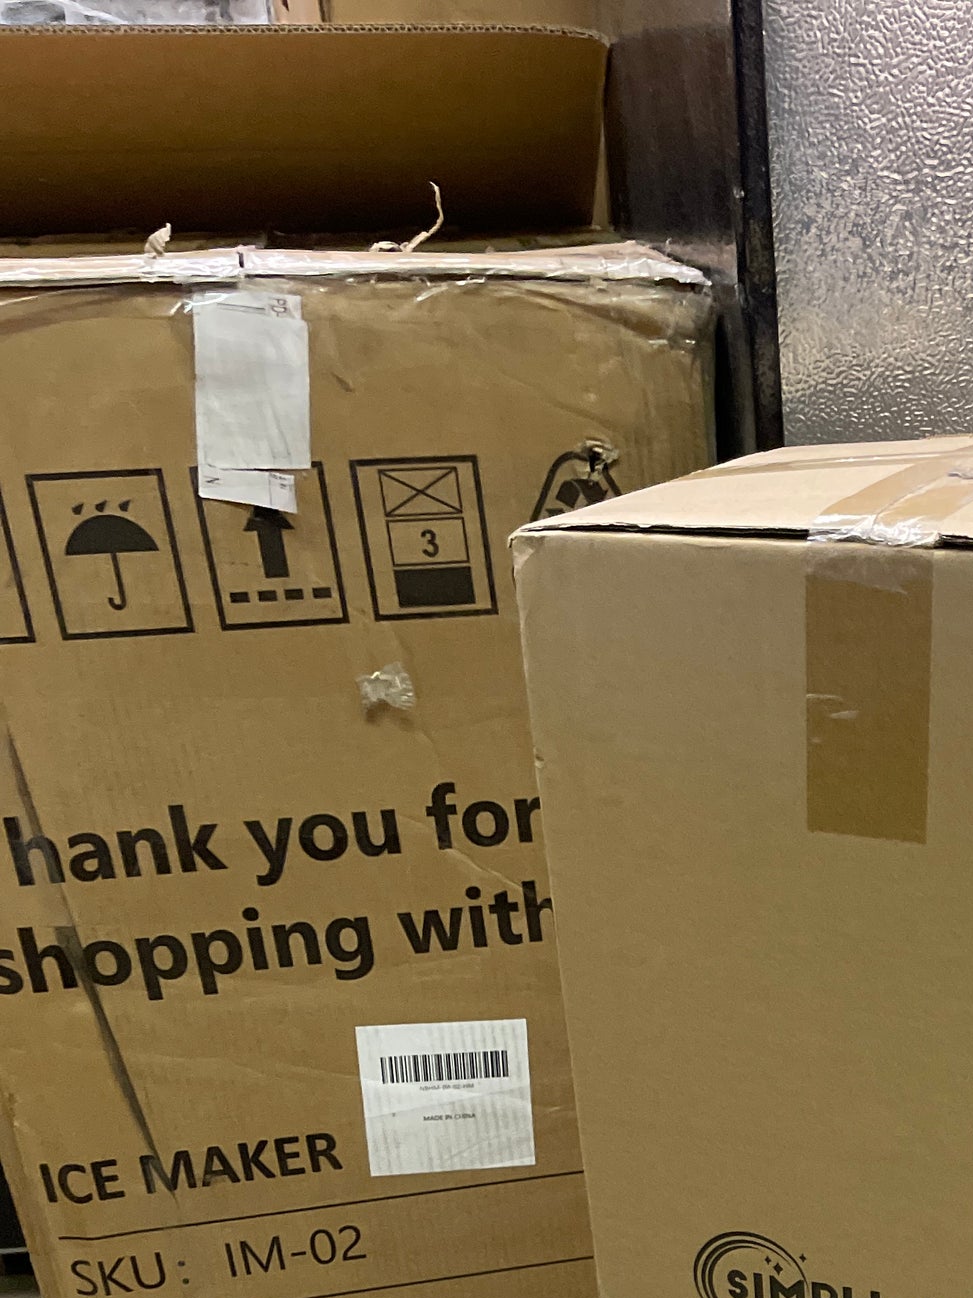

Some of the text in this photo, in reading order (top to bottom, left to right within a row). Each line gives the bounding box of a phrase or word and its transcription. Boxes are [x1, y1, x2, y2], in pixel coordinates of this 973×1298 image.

[421, 529, 440, 558] 3
[243, 808, 402, 887] you
[425, 781, 542, 850] for
[0, 879, 554, 1001] shopping with
[423, 1114, 443, 1122] MADE
[40, 1131, 344, 1204] ICE MAKER
[225, 1224, 368, 1279] IM-02
